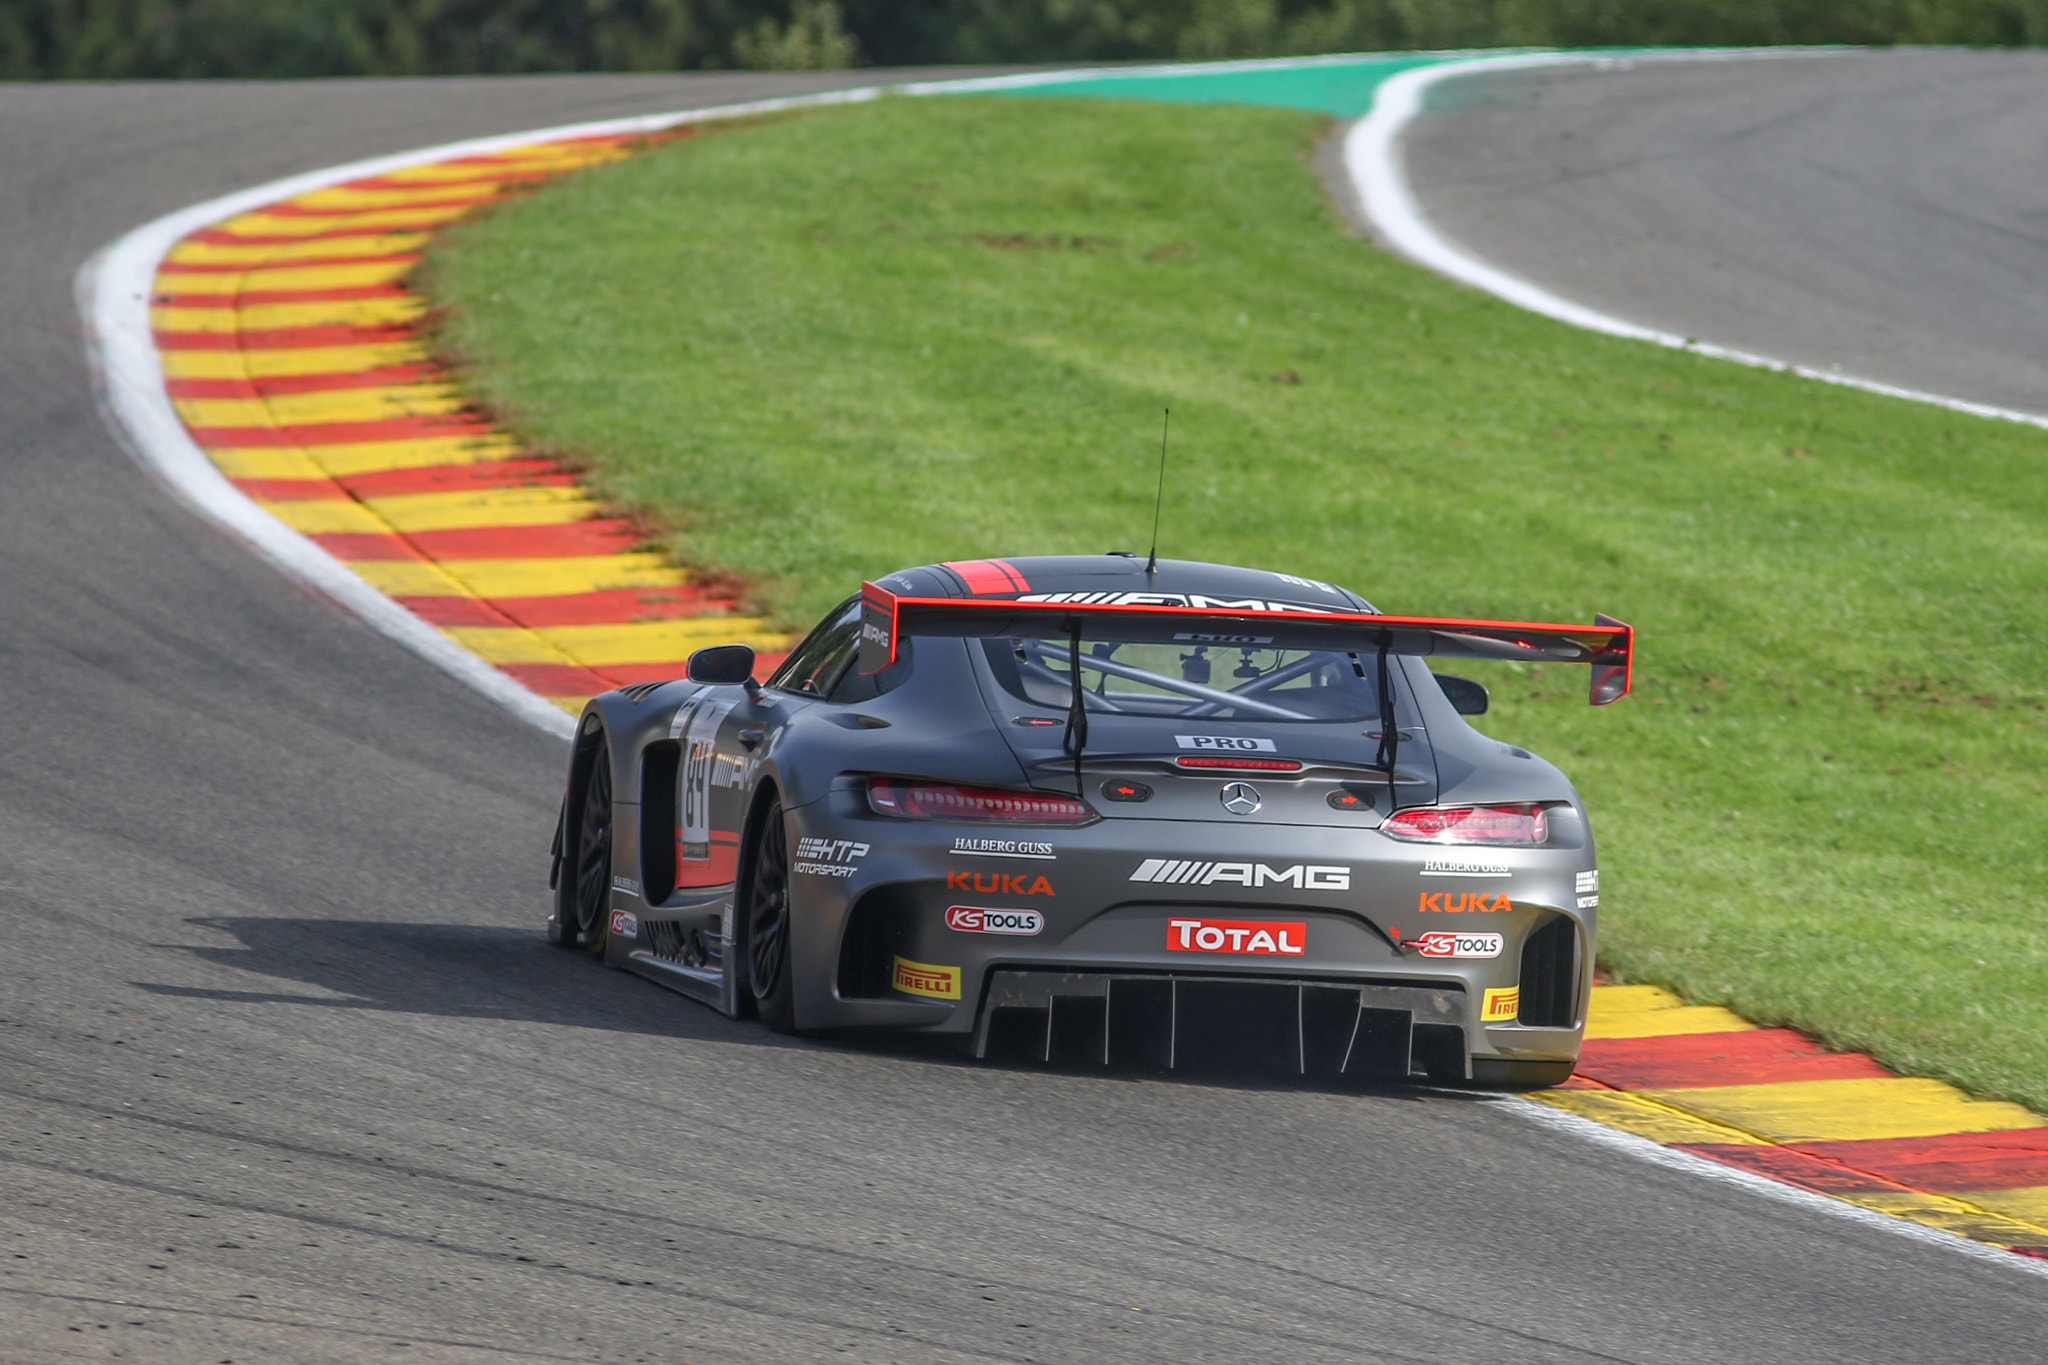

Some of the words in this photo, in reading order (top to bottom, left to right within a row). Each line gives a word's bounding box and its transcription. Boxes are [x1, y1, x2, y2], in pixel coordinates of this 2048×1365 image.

[1192, 737, 1259, 750] PRO
[728, 756, 760, 792] AM
[804, 838, 870, 862] HTP
[954, 838, 1015, 853] HALBERG
[1018, 841, 1053, 854] GUSS
[793, 862, 858, 877] MOTORSPORT
[1199, 862, 1350, 890] AMG
[1425, 859, 1477, 872] HALBERG
[1478, 861, 1509, 872] GUSS
[946, 870, 1056, 896] KUKA
[1419, 892, 1512, 912] KUKA
[952, 910, 983, 927] KS
[983, 914, 1036, 929] TOOLS
[1170, 920, 1302, 953] TOTAL
[1423, 936, 1455, 953] KS
[1455, 939, 1497, 952] TOOLS
[896, 963, 952, 992] PIRELLI
[1489, 992, 1519, 1015] PIRE
